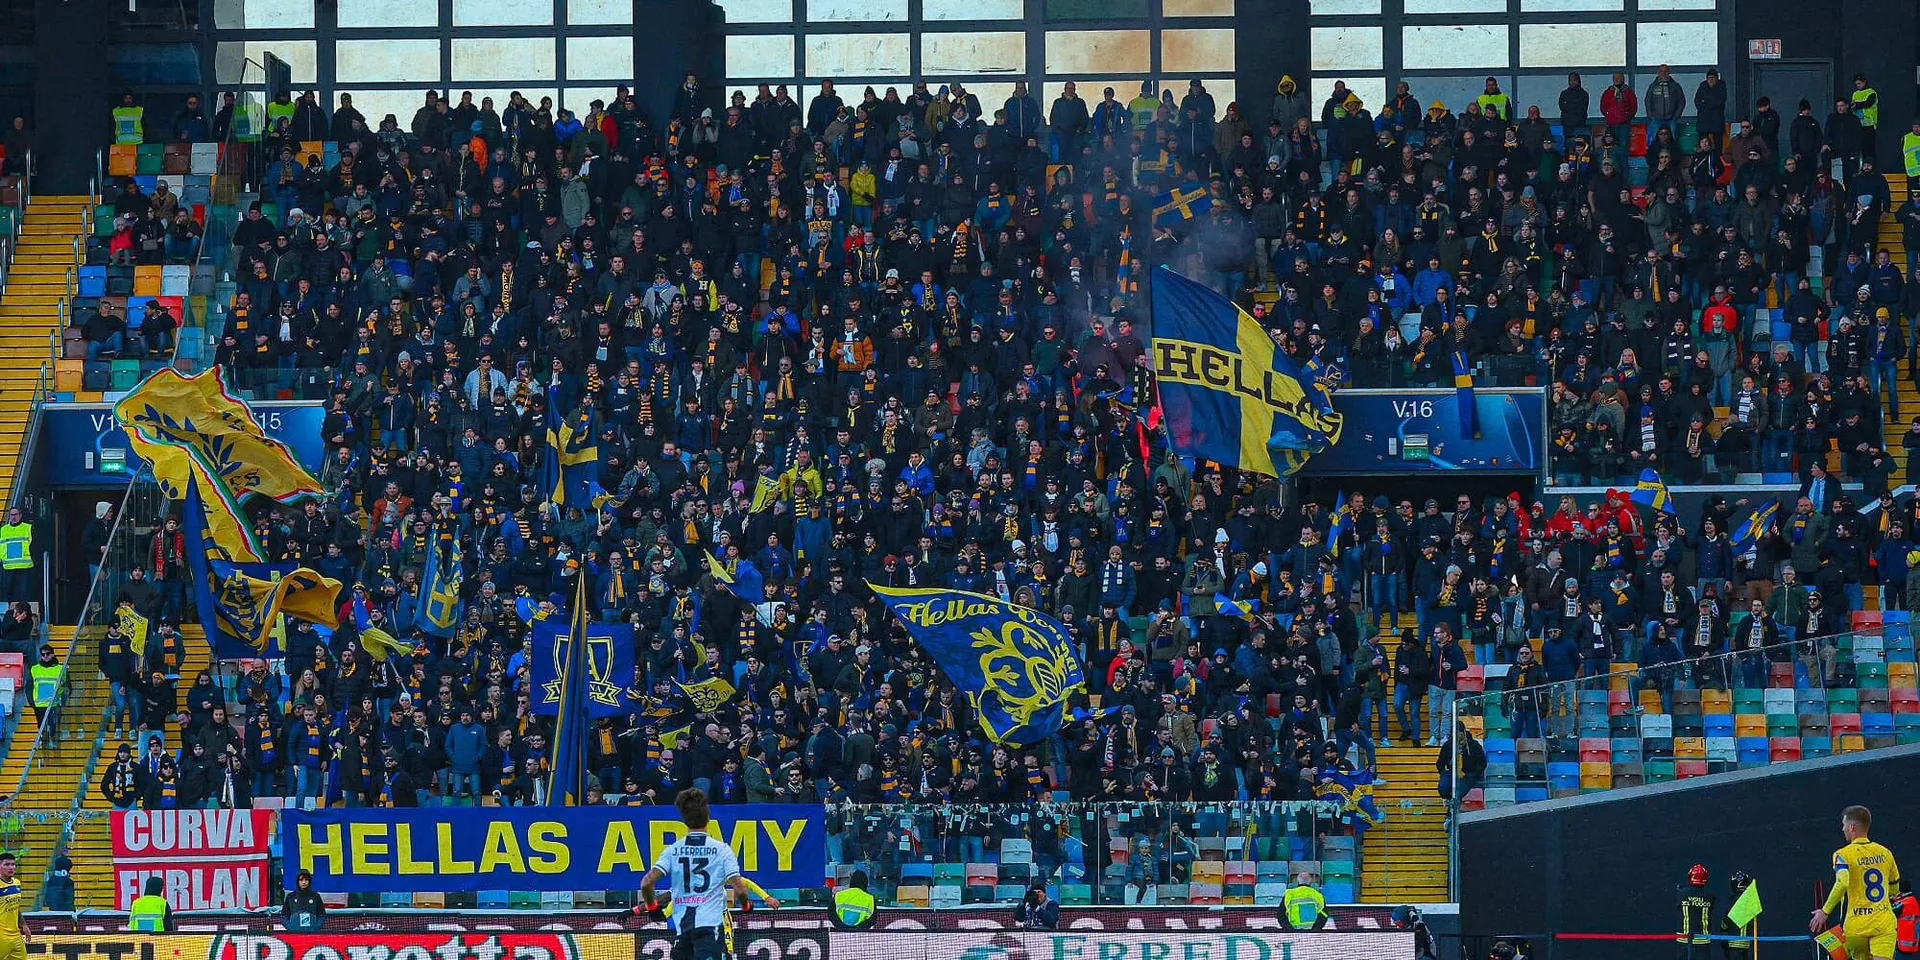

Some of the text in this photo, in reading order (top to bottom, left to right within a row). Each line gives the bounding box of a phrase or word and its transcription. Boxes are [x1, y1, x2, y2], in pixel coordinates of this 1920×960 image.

[1156, 341, 1340, 438] HELLAS
[91, 414, 114, 432] V1
[894, 598, 1000, 627] Hellas
[123, 809, 255, 852] CURVA
[297, 821, 570, 876] HELLAS
[678, 856, 711, 894] 13
[1864, 868, 1885, 903] 8
